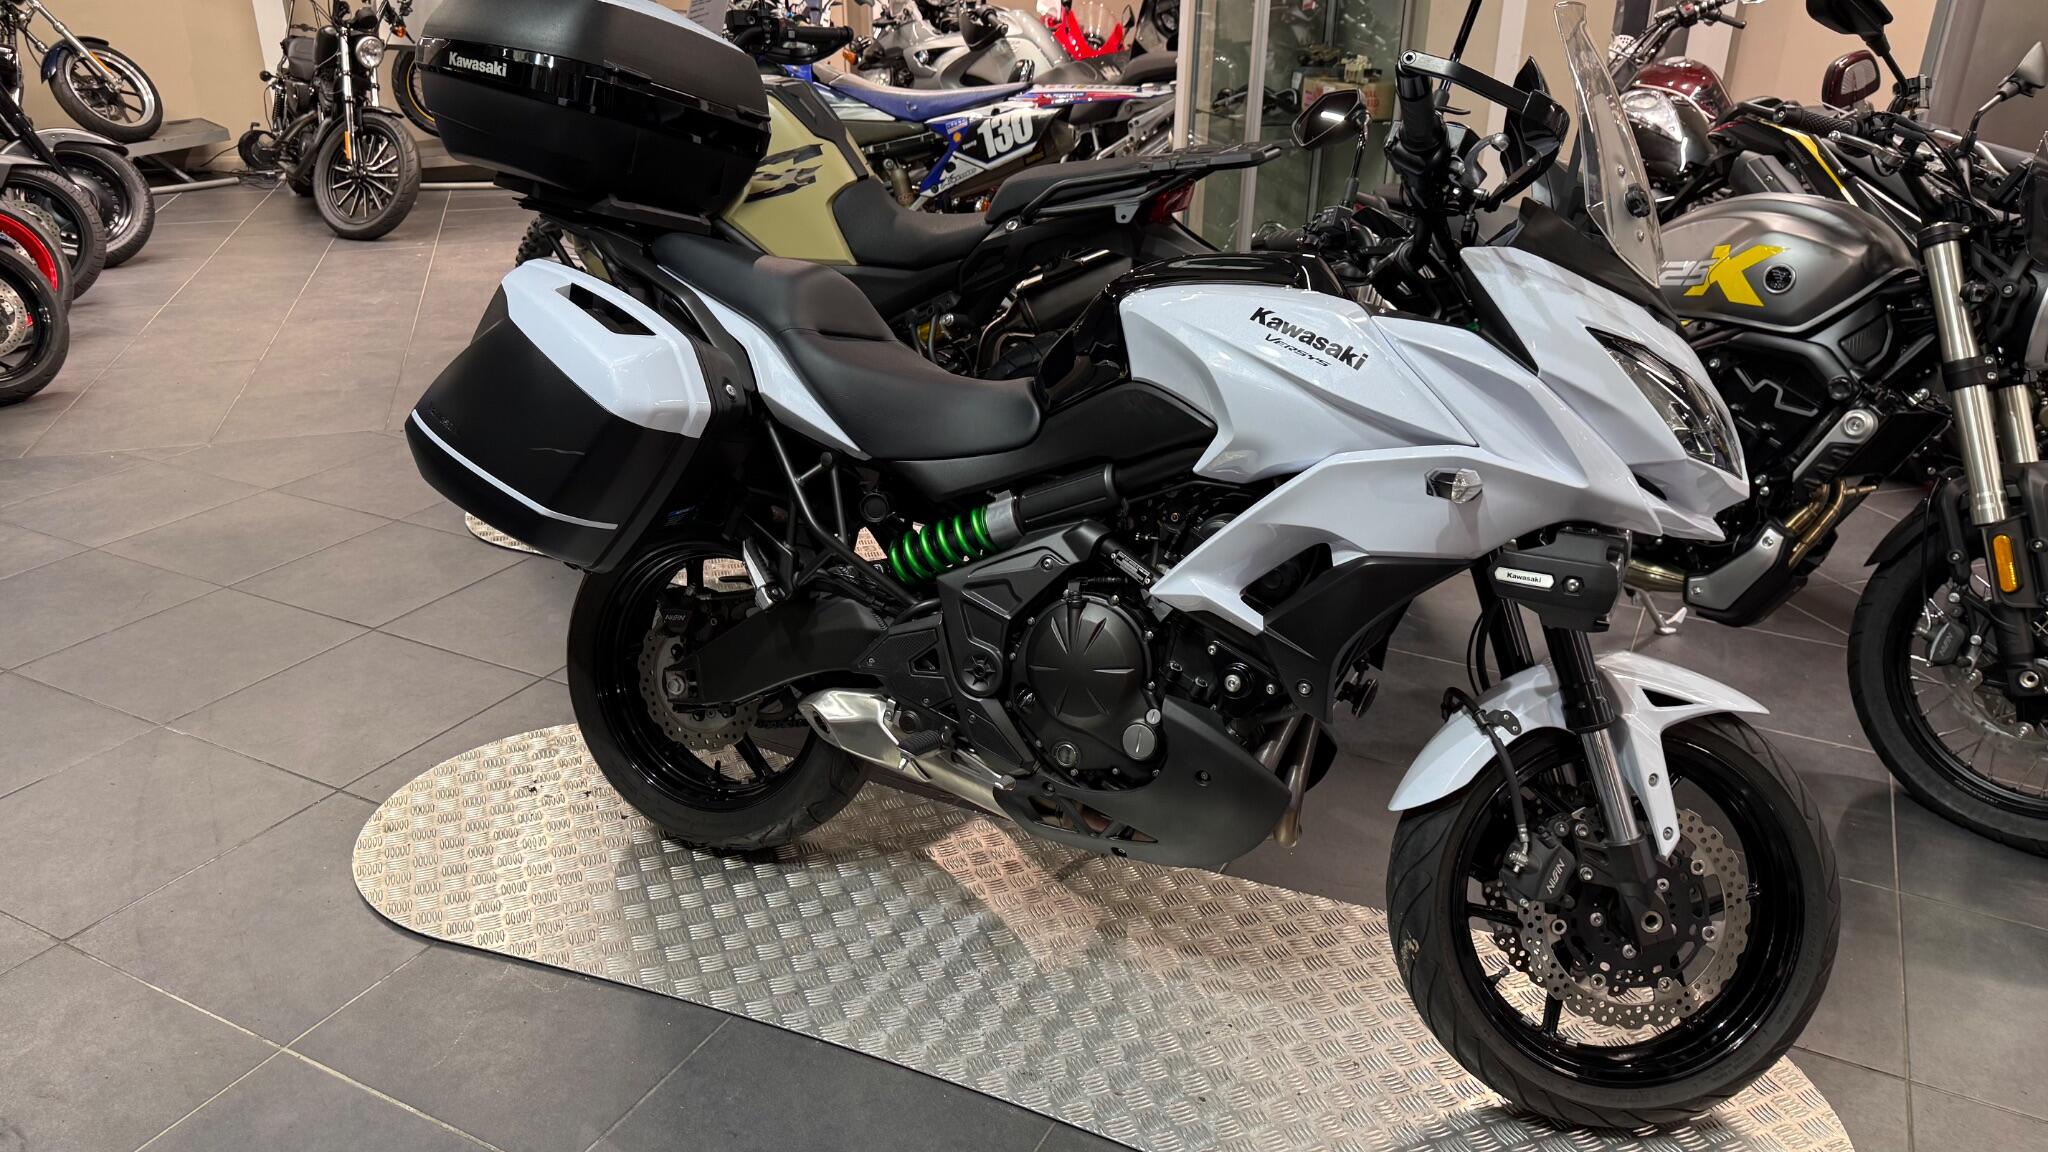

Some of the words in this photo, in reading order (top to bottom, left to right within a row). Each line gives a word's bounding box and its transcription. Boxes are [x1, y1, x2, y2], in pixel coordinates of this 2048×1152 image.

[449, 51, 507, 77] Kawasaki
[977, 111, 1033, 158] 130
[1250, 306, 1368, 371] Kawasaki
[1265, 333, 1332, 367] VERSYS
[1506, 571, 1542, 583] Kawasaki
